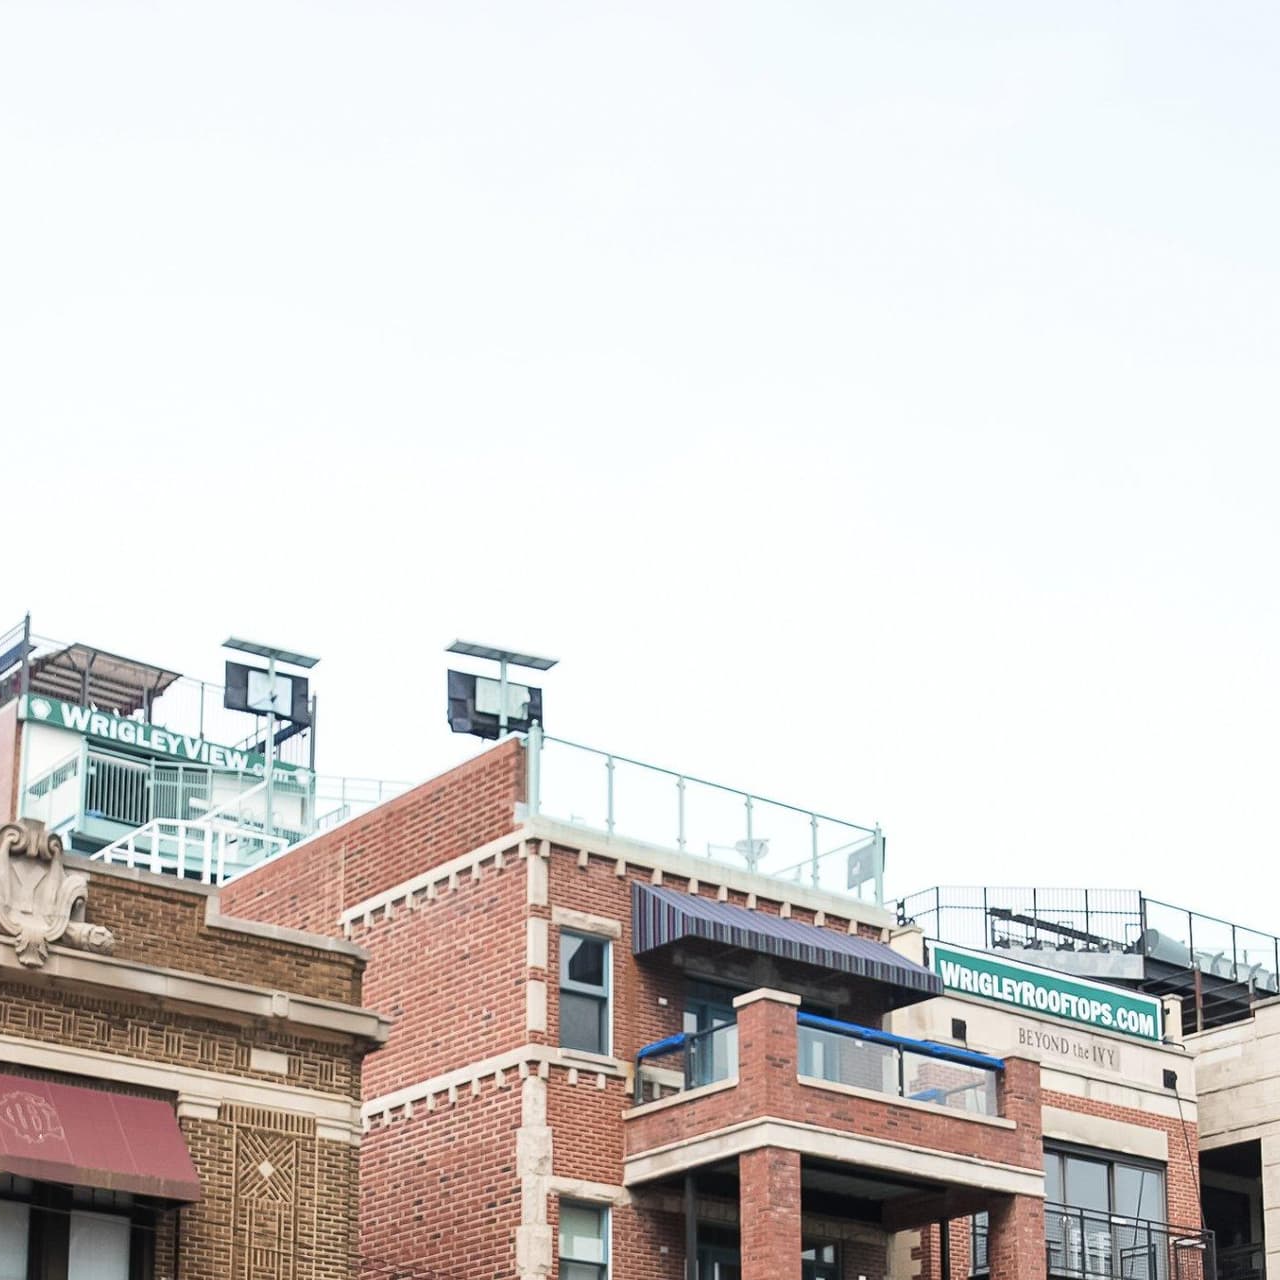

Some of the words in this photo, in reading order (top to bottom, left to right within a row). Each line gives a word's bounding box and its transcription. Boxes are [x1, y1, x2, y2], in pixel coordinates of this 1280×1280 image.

[939, 959, 1154, 1037] WRIGLEYROOFTOPS.COM
[1018, 1027, 1070, 1055] BEYOND
[1073, 1043, 1089, 1060] the
[1092, 1046, 1115, 1066] IVY
